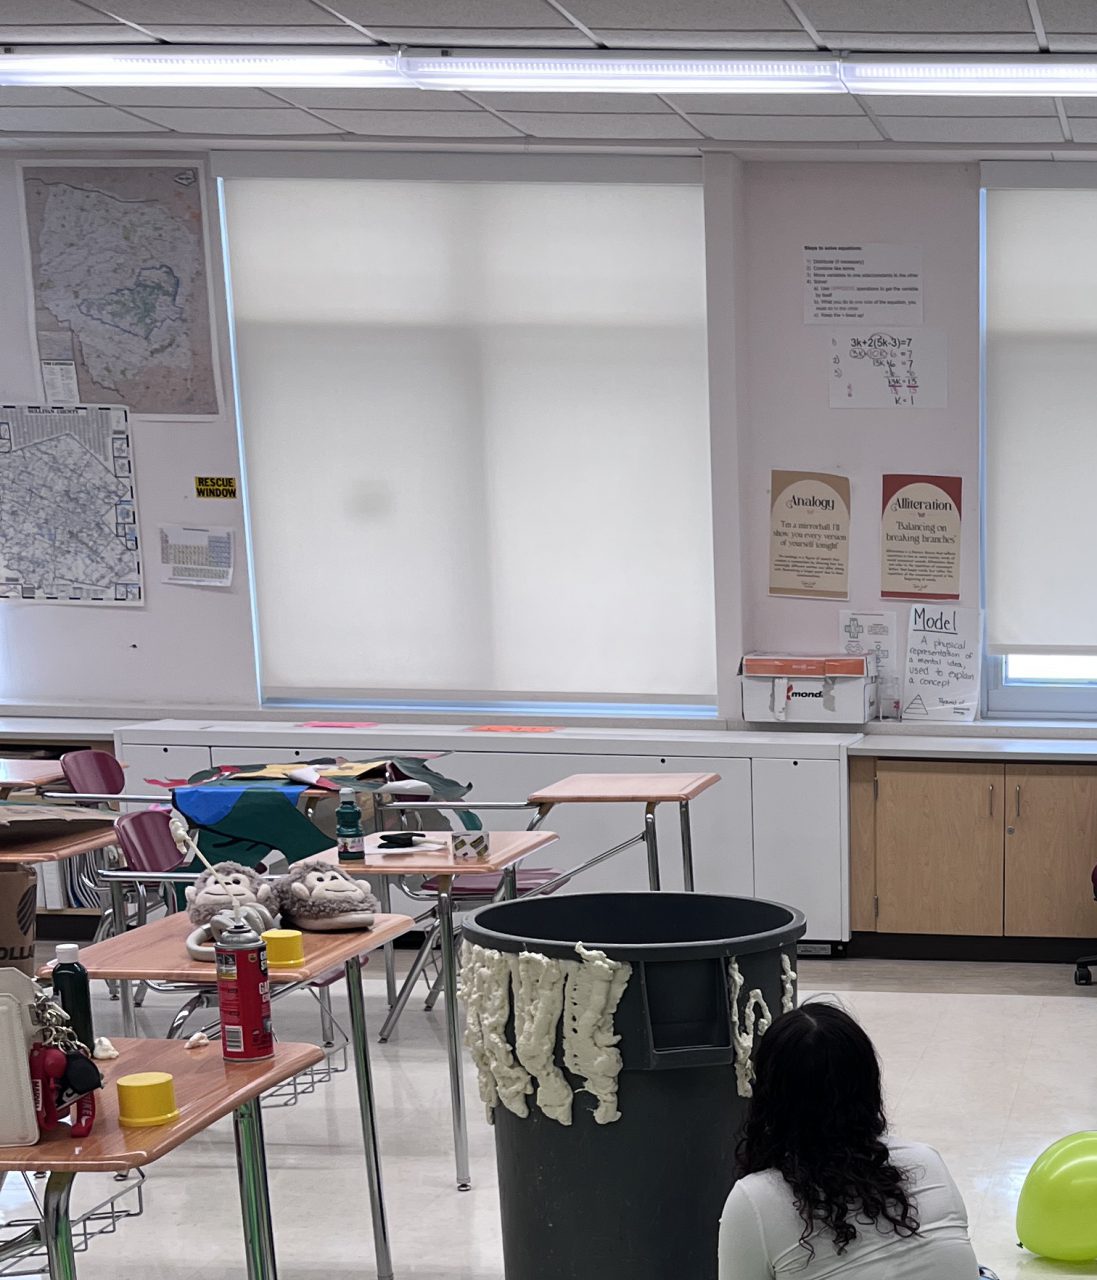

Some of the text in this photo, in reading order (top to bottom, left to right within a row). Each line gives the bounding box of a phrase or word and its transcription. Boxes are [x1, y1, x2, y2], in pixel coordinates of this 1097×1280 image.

[198, 477, 234, 487] RESCUE
[196, 488, 237, 498] WINDOW
[786, 495, 835, 511] Analogy
[890, 498, 952, 513] Alliteration
[914, 607, 957, 631] Model
[791, 690, 824, 698] mond
